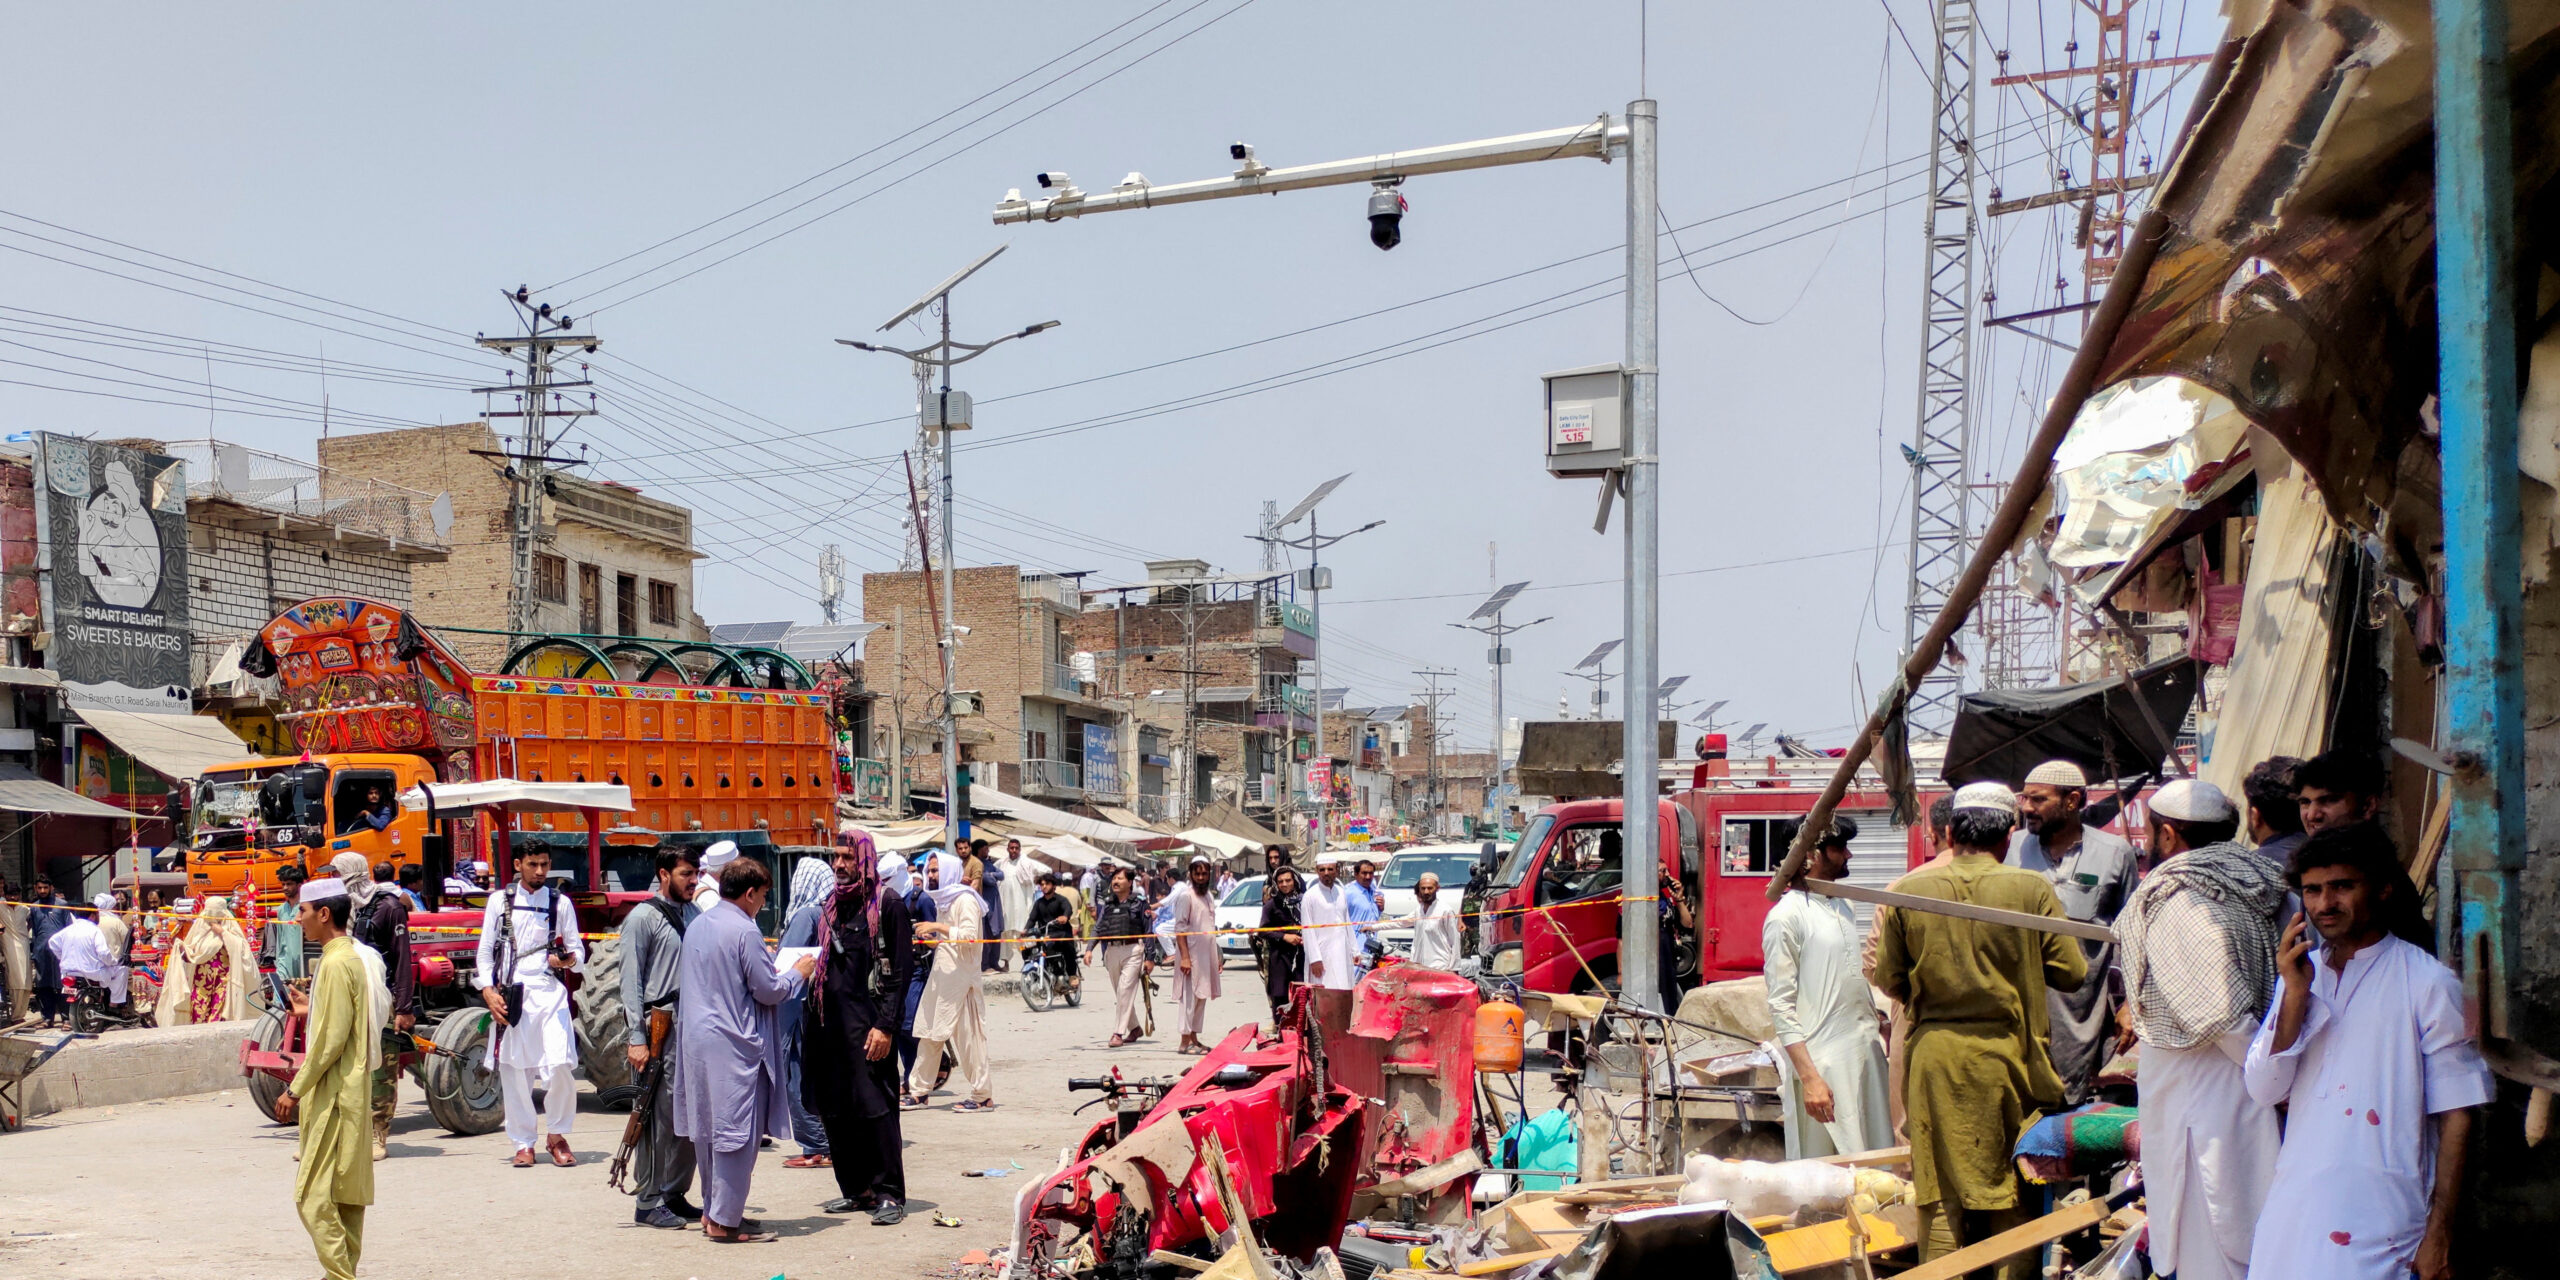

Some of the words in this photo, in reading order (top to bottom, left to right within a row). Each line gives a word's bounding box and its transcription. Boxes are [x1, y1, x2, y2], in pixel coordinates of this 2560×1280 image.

[1573, 432, 1584, 441] 15
[84, 606, 120, 622] SMART
[122, 611, 163, 627] DELIGHT
[67, 625, 120, 645] SWEETS
[123, 630, 132, 646] &
[135, 632, 181, 651] BAKERS
[70, 692, 88, 701] Main
[127, 696, 144, 706] Road
[277, 828, 293, 843] 65
